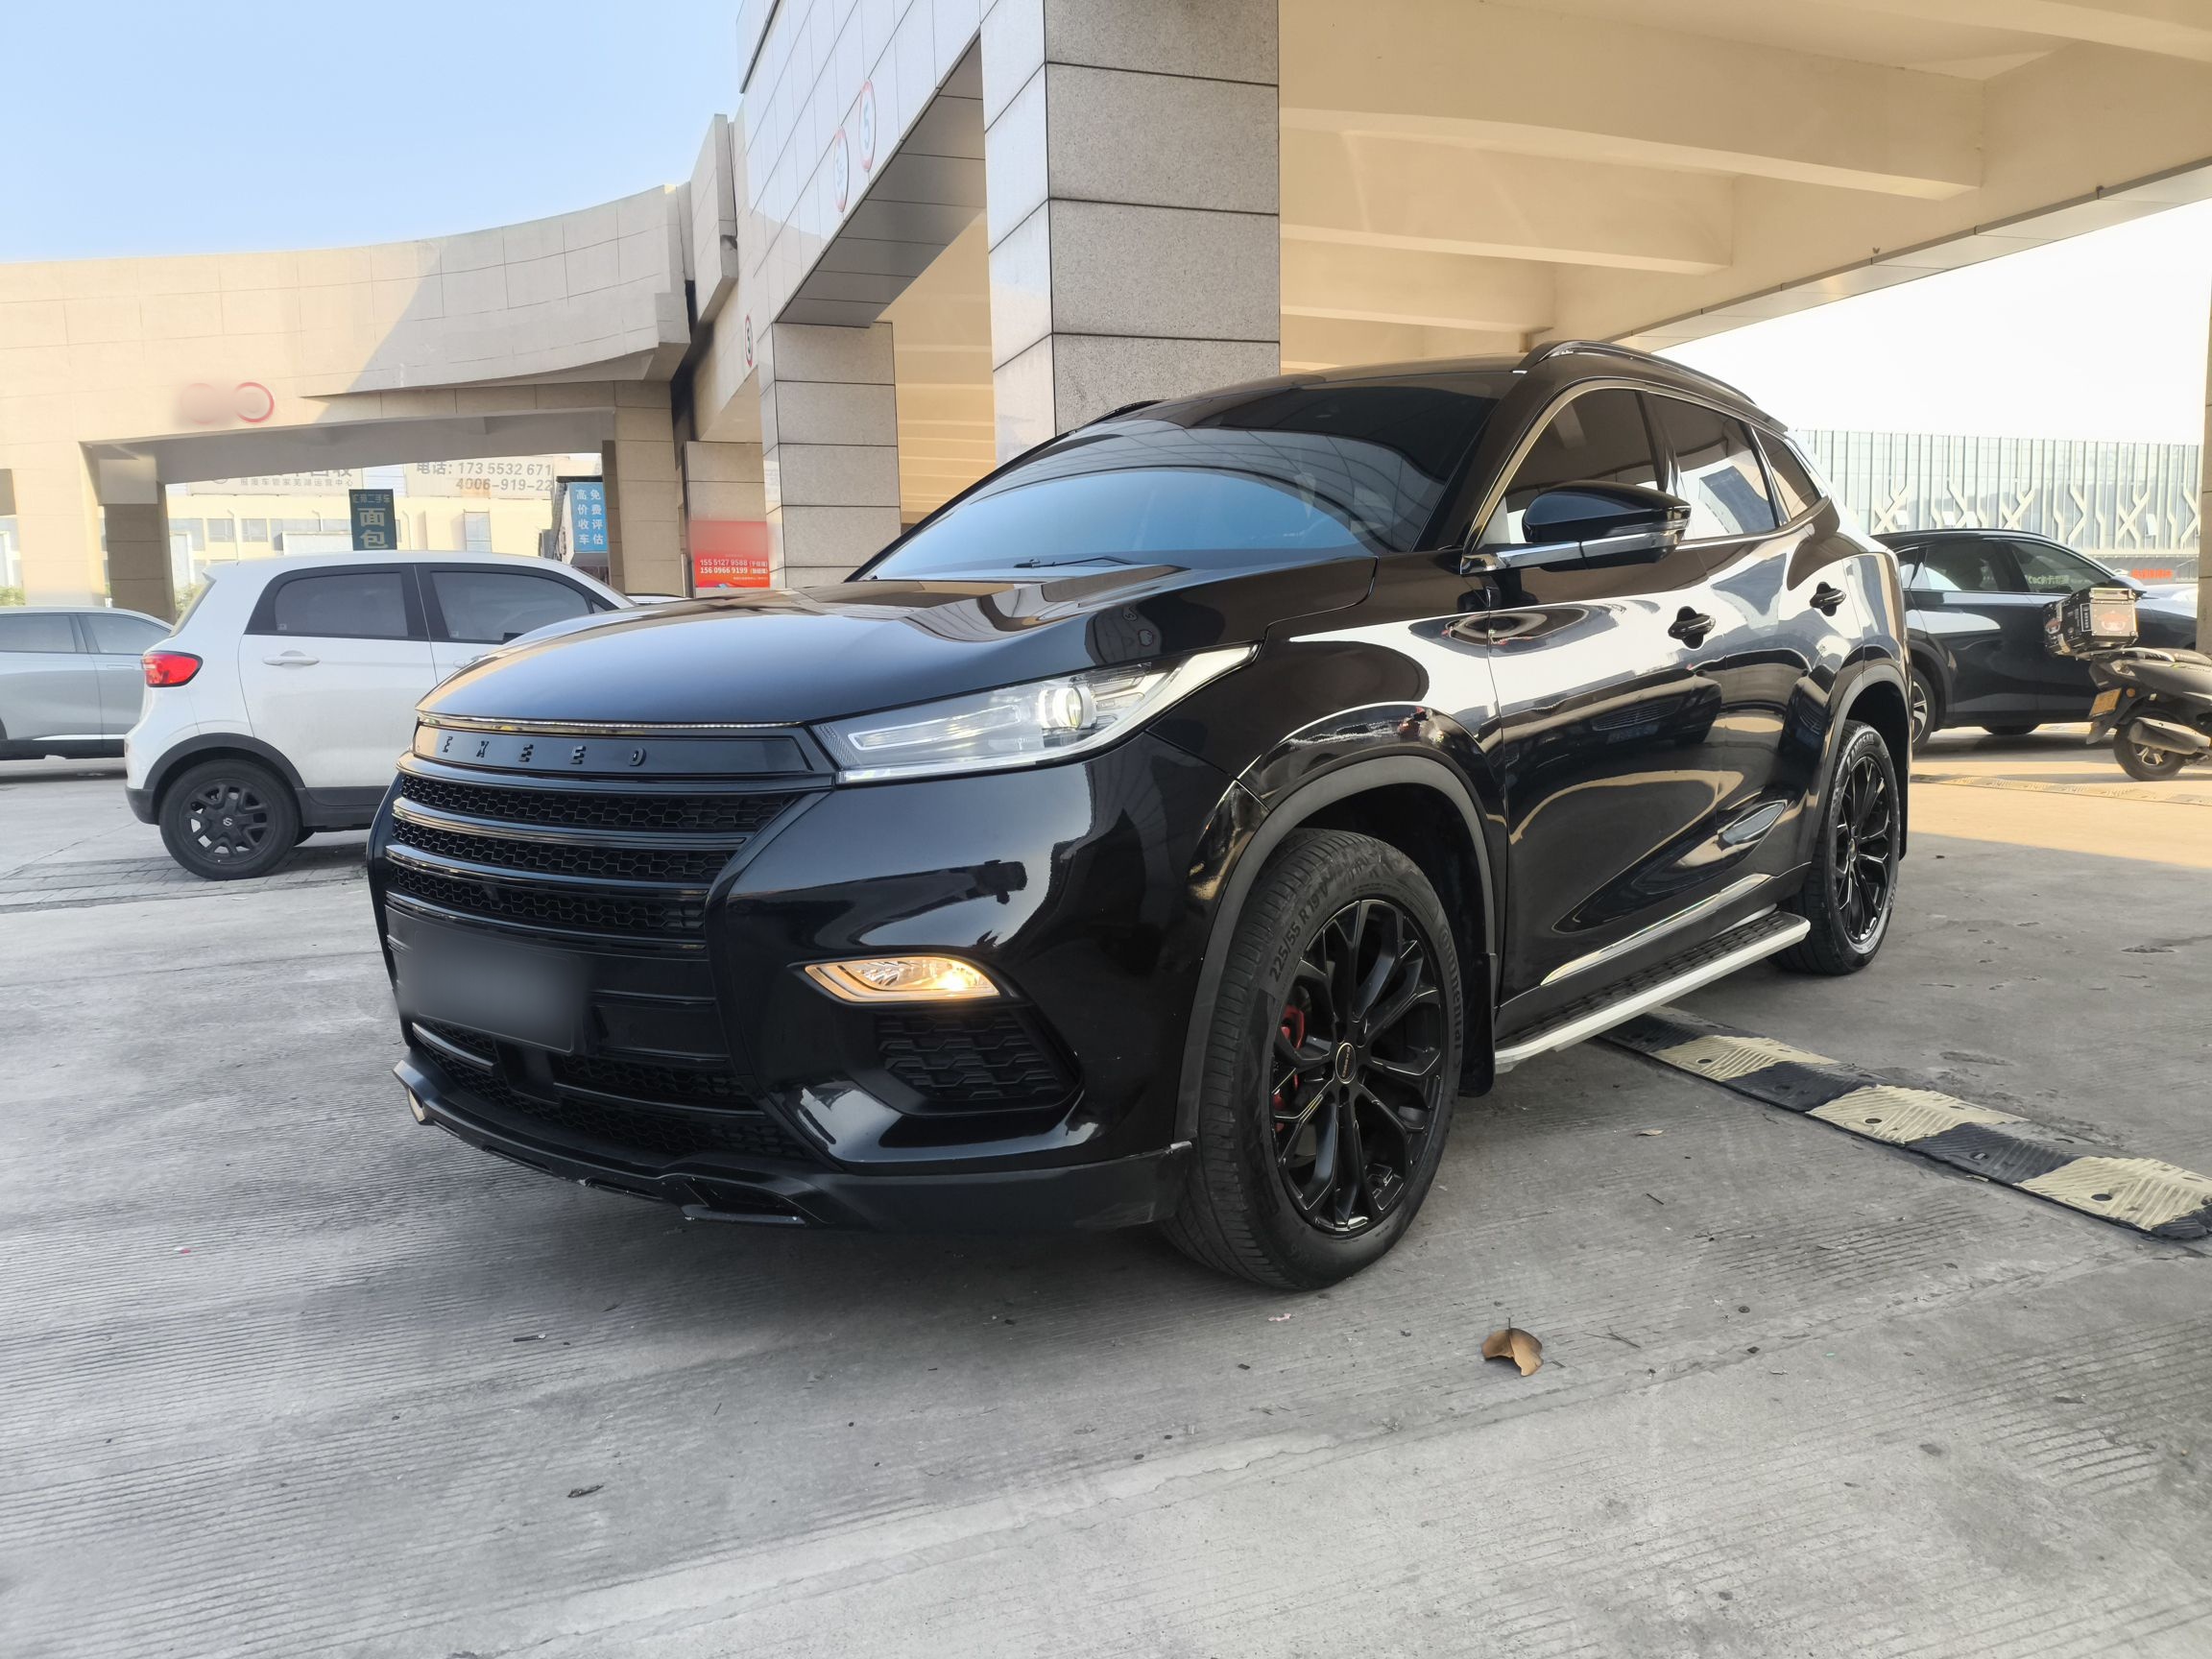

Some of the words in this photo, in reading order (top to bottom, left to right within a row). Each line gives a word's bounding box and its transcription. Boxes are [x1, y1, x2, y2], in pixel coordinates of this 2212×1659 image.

[458, 462, 484, 475] 173
[487, 463, 523, 476] 5532
[526, 464, 552, 476] 671
[357, 507, 388, 549] 面包
[576, 489, 590, 545] 高价收车
[589, 489, 604, 545] 免费评估
[443, 735, 647, 767] EXEED
[1269, 923, 1301, 982] 225/55
